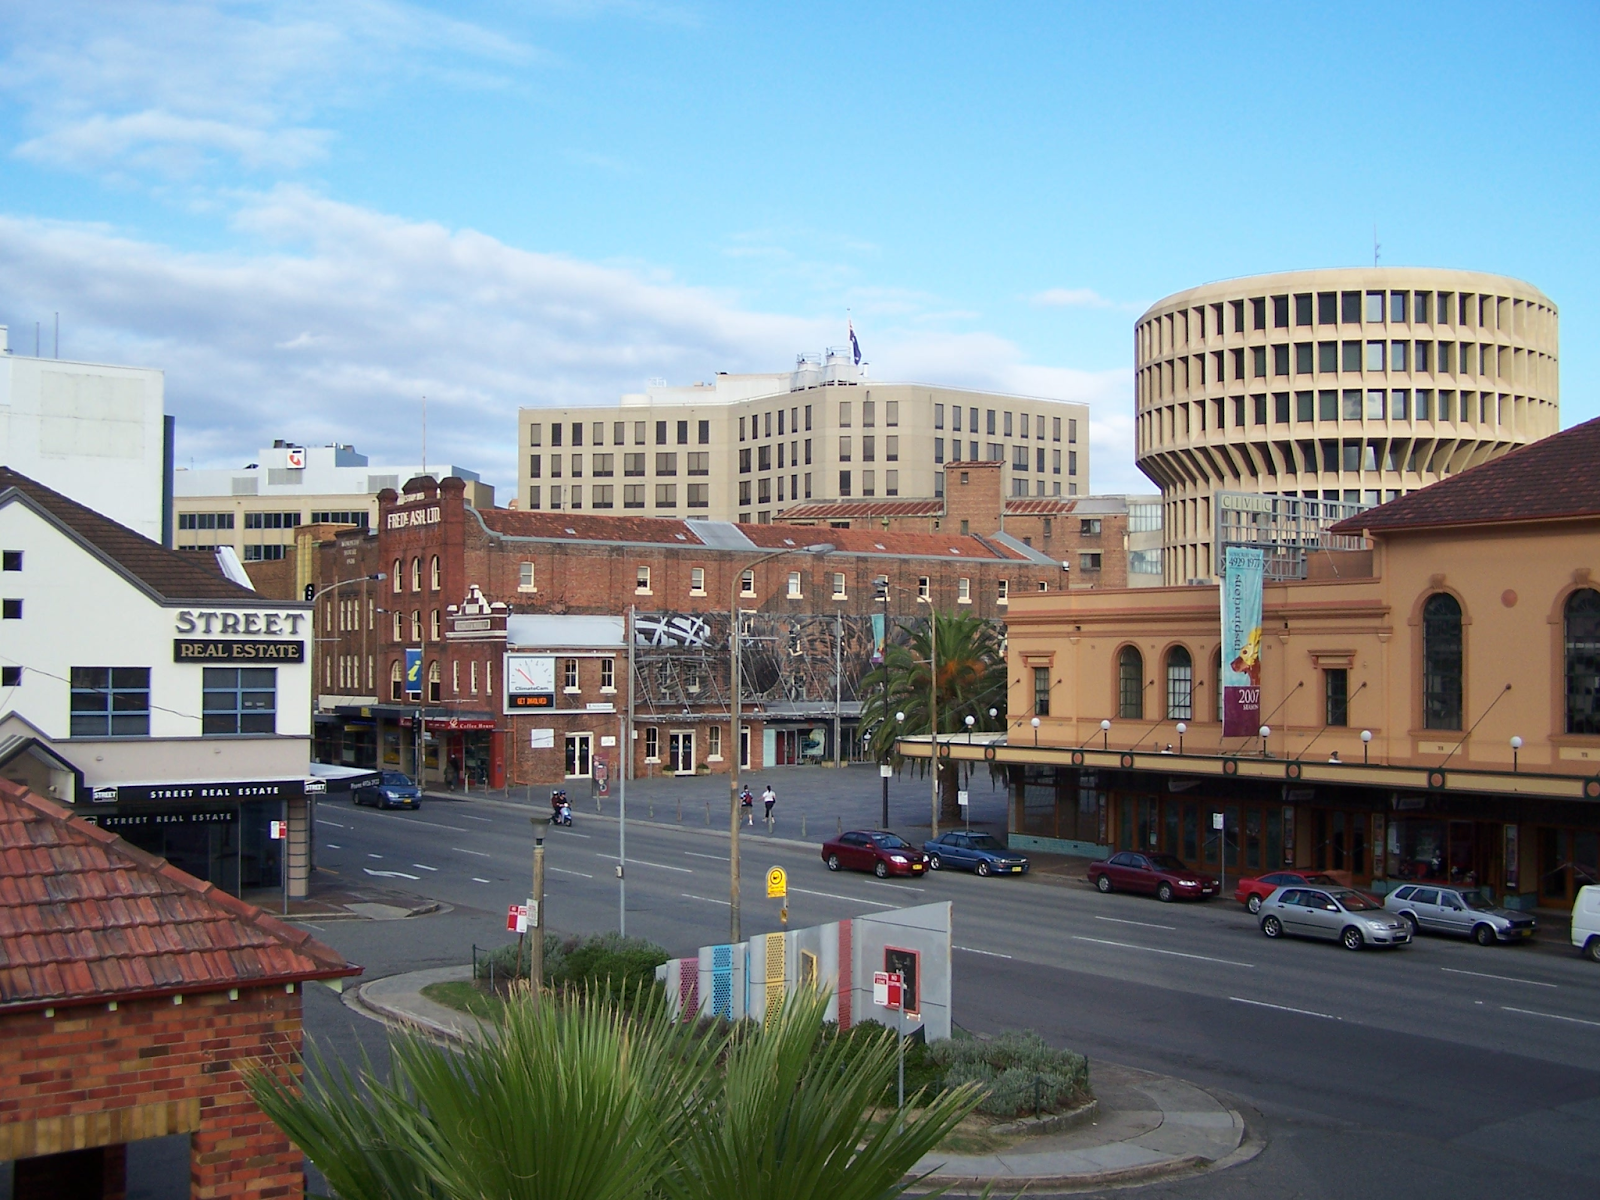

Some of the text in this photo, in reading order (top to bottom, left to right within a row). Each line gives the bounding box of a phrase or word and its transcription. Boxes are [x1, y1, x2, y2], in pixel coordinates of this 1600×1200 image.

[1223, 496, 1271, 511] CIVIC
[1229, 557, 1245, 567] 4929
[1232, 574, 1244, 650] inspirations
[175, 611, 305, 635] STREET
[181, 644, 300, 658] REAL ESTATE
[1239, 689, 1259, 704] 2007
[94, 791, 116, 799] STREET
[150, 787, 279, 799] STREET REAL ESTATE
[106, 813, 232, 825] STREET REAL ESTATE
